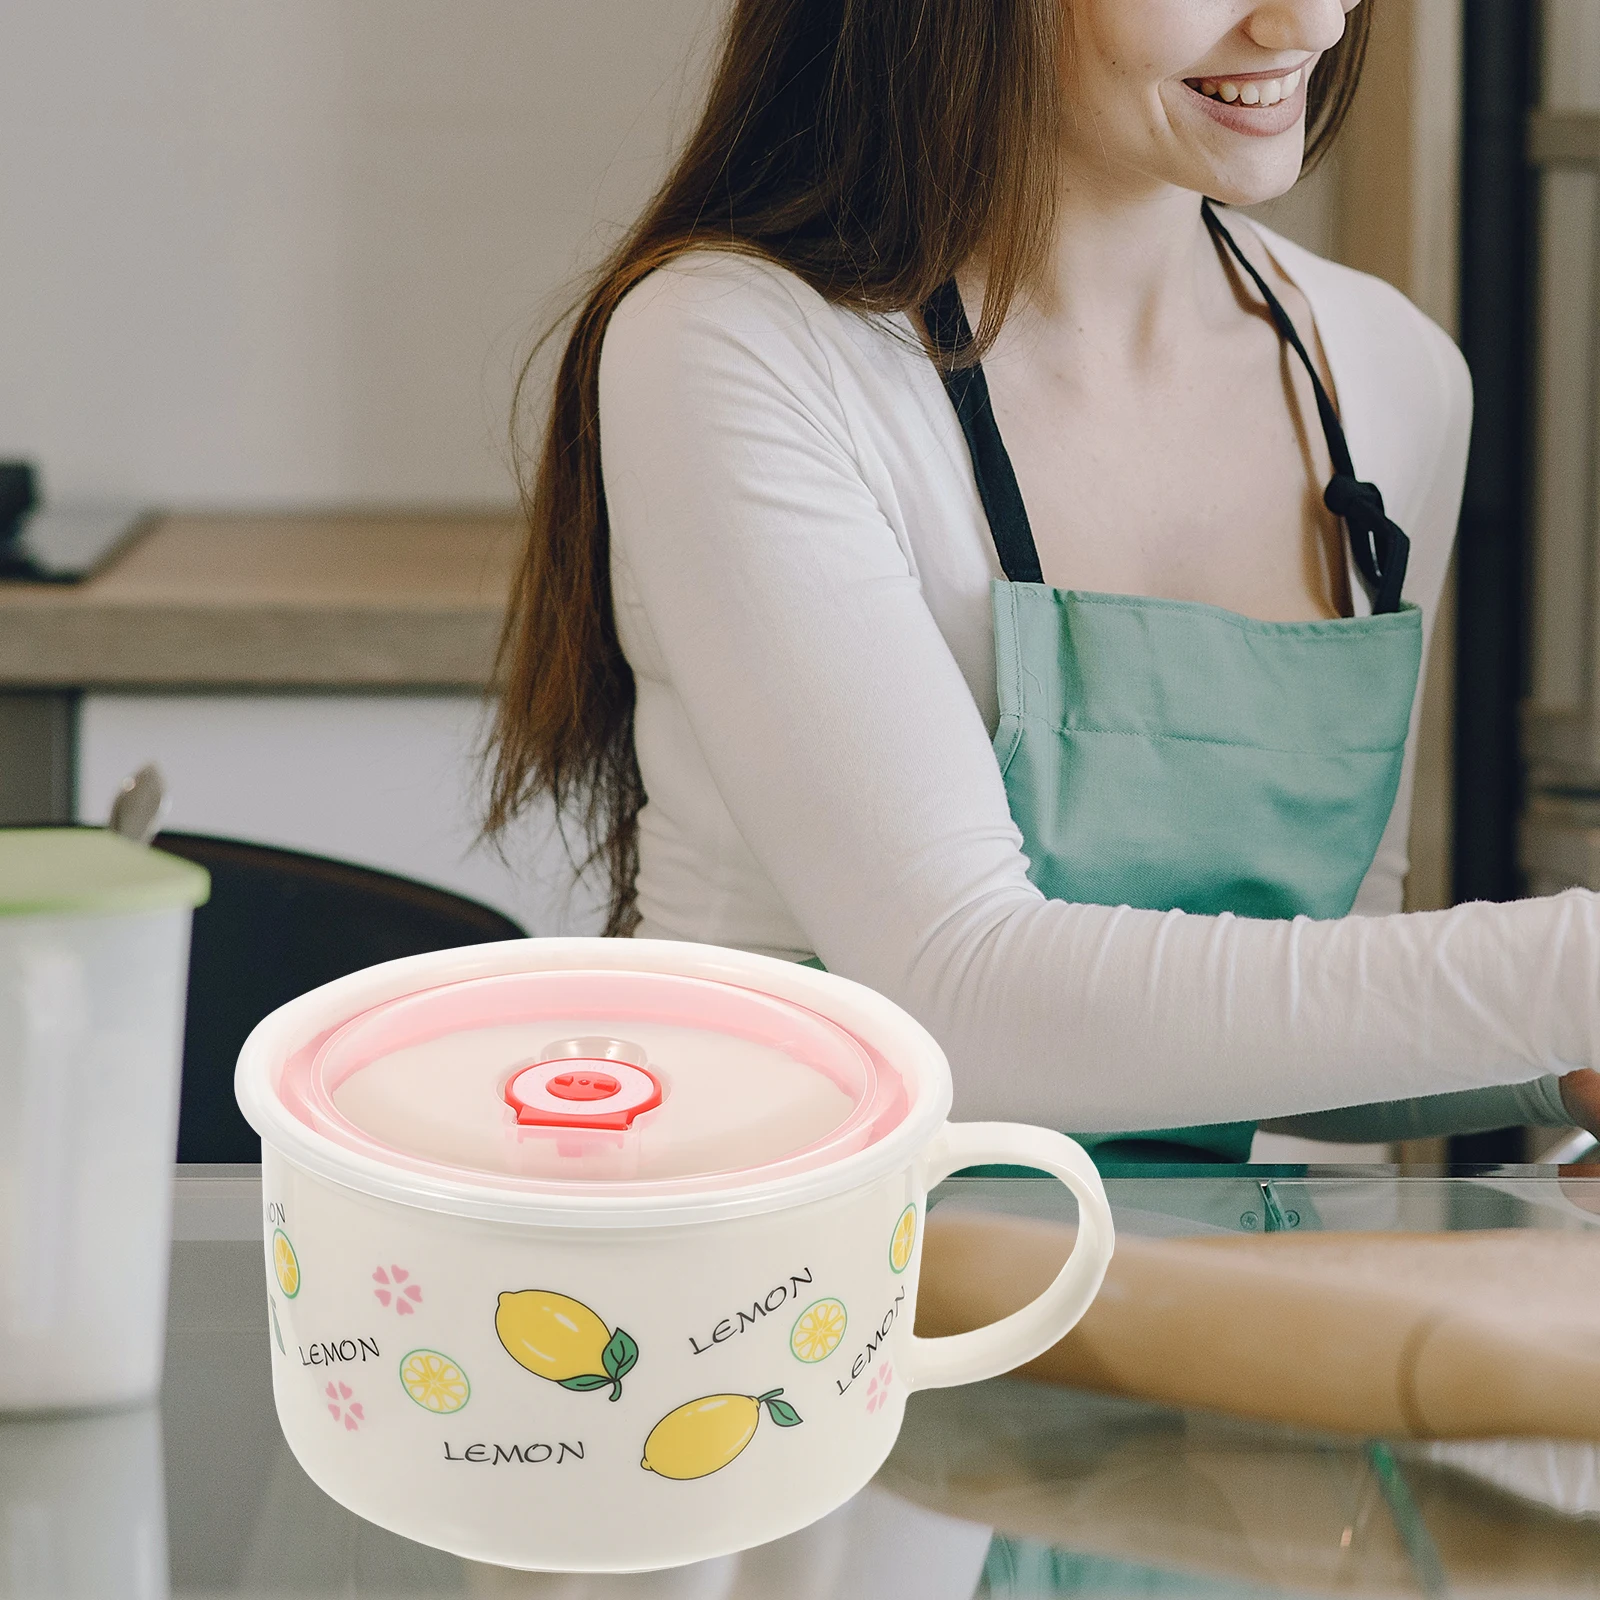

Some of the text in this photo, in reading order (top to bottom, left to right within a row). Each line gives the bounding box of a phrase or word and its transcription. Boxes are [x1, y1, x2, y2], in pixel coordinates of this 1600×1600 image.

[266, 1202, 286, 1226] ON
[689, 1267, 813, 1355] LEMON
[299, 1337, 380, 1366] LEMON
[836, 1285, 905, 1396] LEMON
[443, 1441, 585, 1465] LEMON
